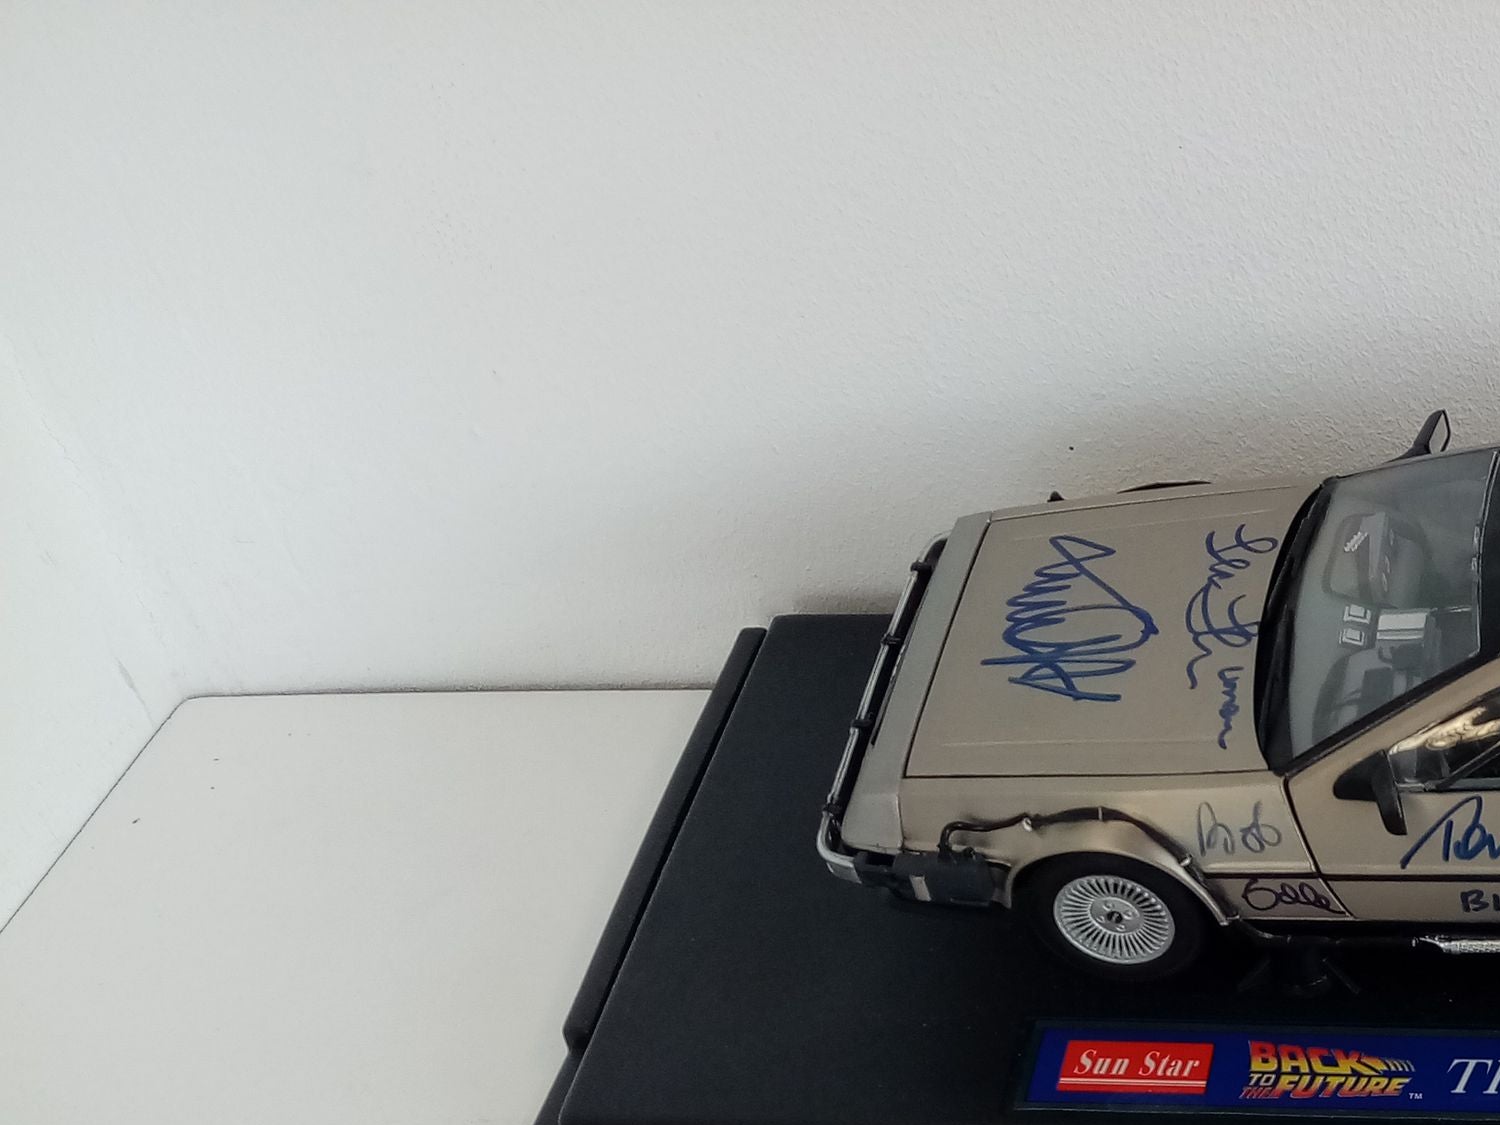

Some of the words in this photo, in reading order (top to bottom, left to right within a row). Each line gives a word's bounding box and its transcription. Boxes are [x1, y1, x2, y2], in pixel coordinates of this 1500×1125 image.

[1074, 1049, 1130, 1075] Sun
[1138, 1050, 1200, 1077] Star
[1249, 1040, 1382, 1076] BACK
[1239, 1085, 1282, 1099] THE
[1277, 1074, 1412, 1098] FUTURE
[1249, 1073, 1276, 1086] TO
